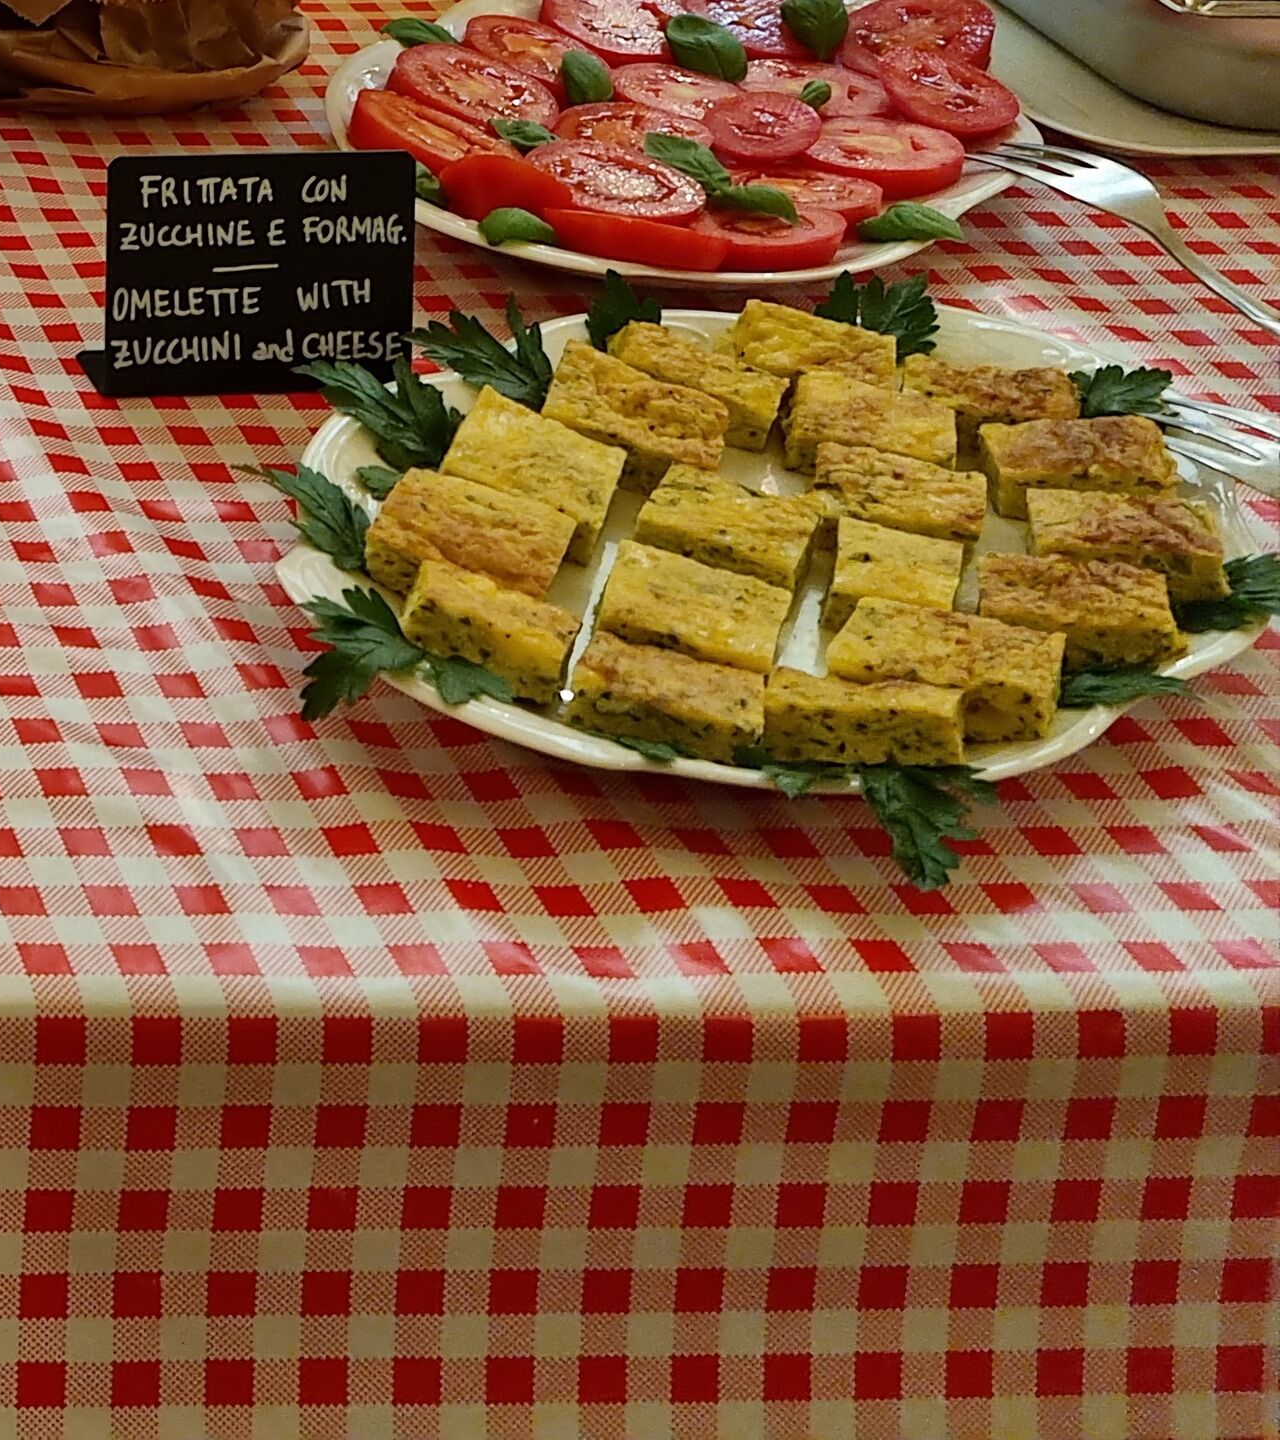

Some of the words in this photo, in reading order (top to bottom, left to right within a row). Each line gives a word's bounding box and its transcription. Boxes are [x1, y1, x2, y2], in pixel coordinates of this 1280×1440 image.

[139, 175, 274, 209] FRITTATA
[301, 174, 347, 203] CON
[119, 219, 256, 251] ZUCCHINE
[266, 218, 287, 246] E
[302, 213, 407, 245] FORMAG.
[112, 286, 262, 322] OMELETTE
[296, 278, 371, 312] WITH
[110, 330, 241, 370] ZUCCHINI
[251, 328, 294, 363] and
[301, 330, 403, 361] CHEESE
